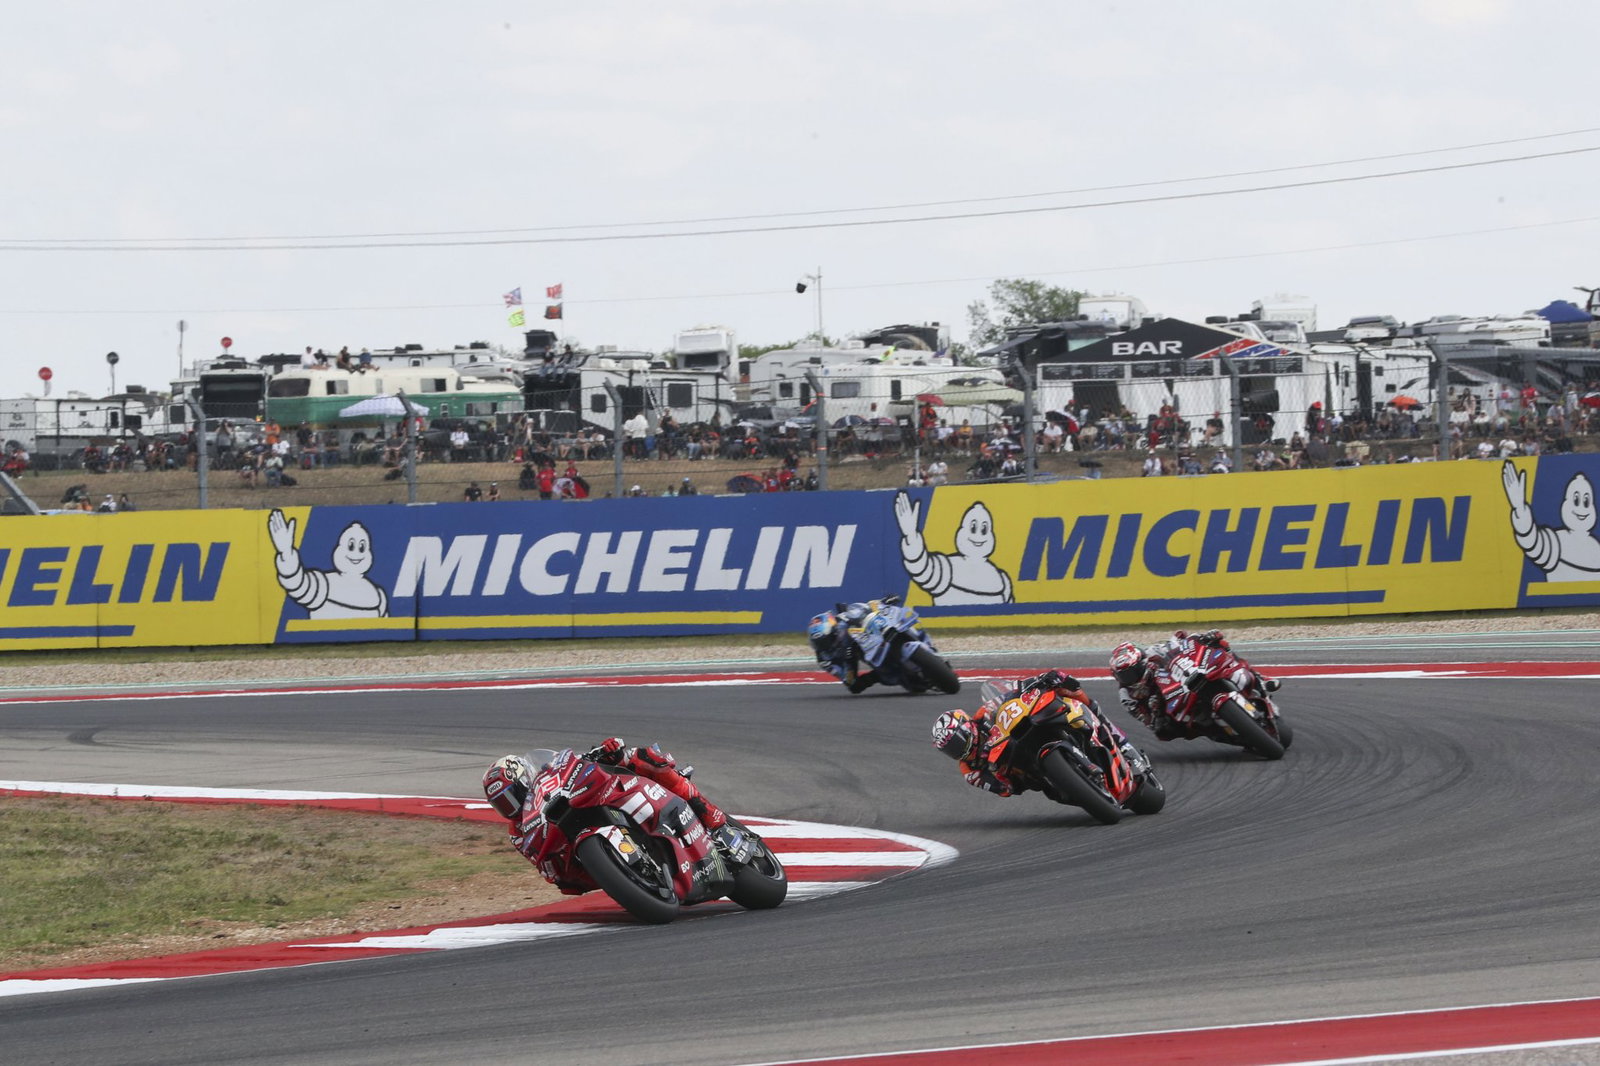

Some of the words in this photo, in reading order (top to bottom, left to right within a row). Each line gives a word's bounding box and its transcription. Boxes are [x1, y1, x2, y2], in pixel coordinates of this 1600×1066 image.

[1112, 340, 1183, 356] BAR
[392, 525, 857, 597] MICHELIN
[1018, 495, 1472, 581] MICHELIN
[0, 542, 231, 607] ELIN
[998, 701, 1023, 730] 23
[565, 762, 583, 791] Lenovo
